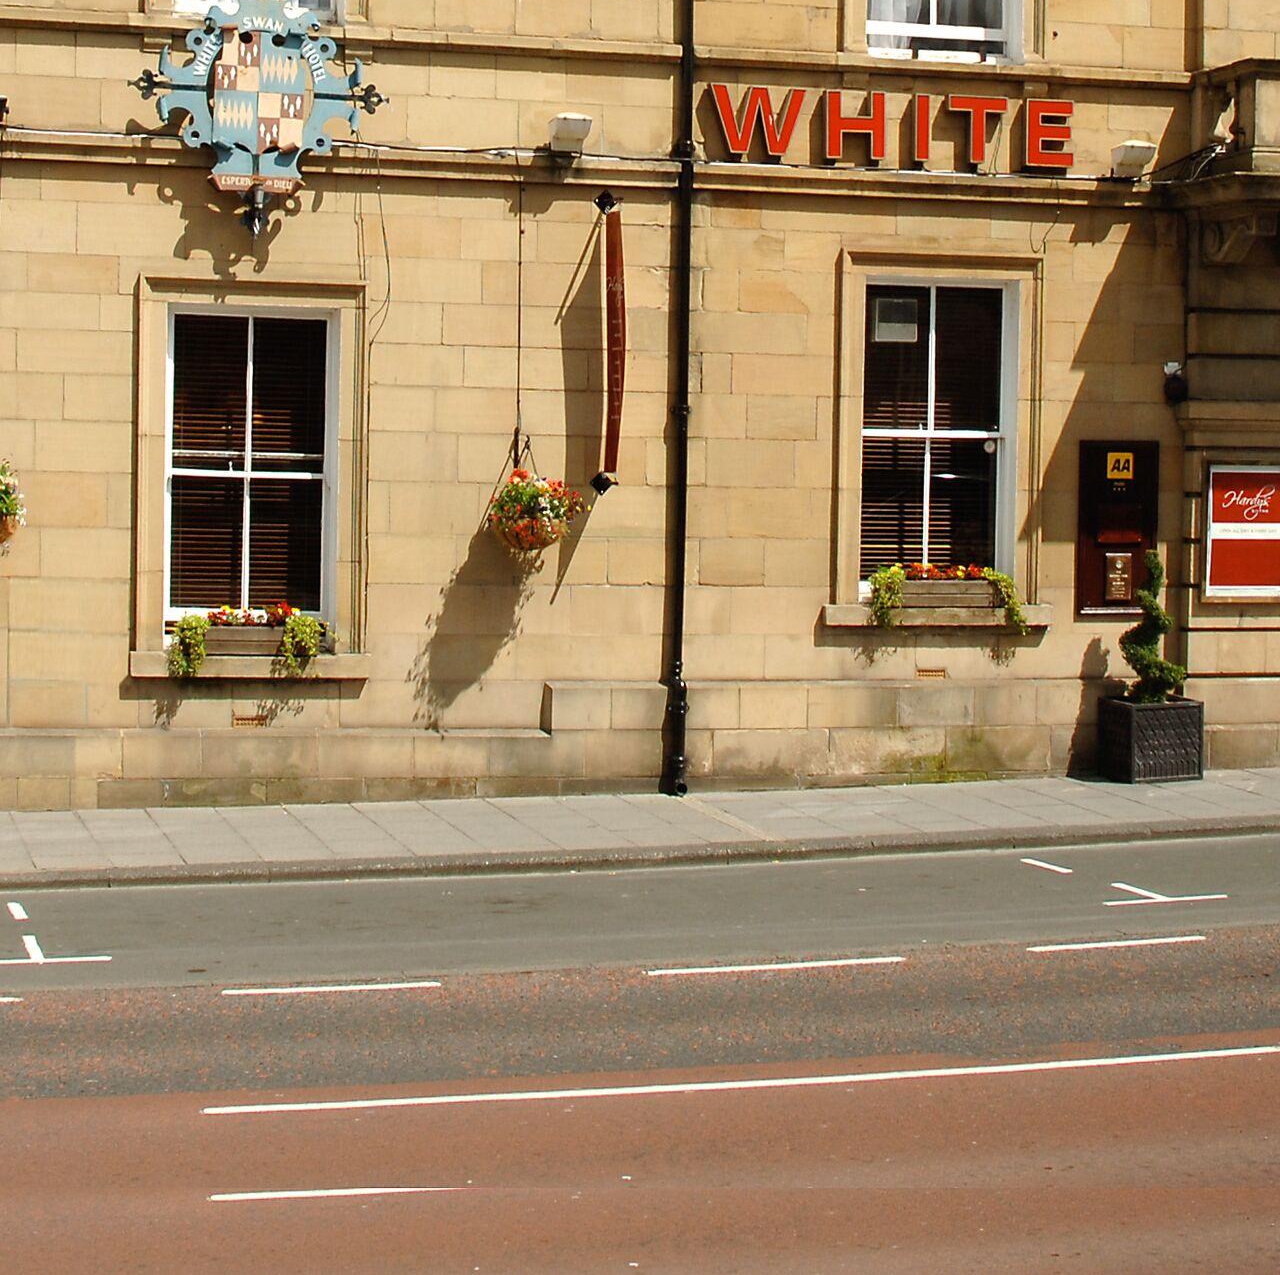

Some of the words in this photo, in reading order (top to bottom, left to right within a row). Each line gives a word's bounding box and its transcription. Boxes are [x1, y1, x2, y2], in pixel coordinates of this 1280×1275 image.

[242, 16, 284, 32] SWAN
[192, 34, 222, 77] WHITE
[302, 43, 326, 84] HOTEL
[709, 83, 1075, 168] WHITE
[1111, 458, 1131, 472] AA
